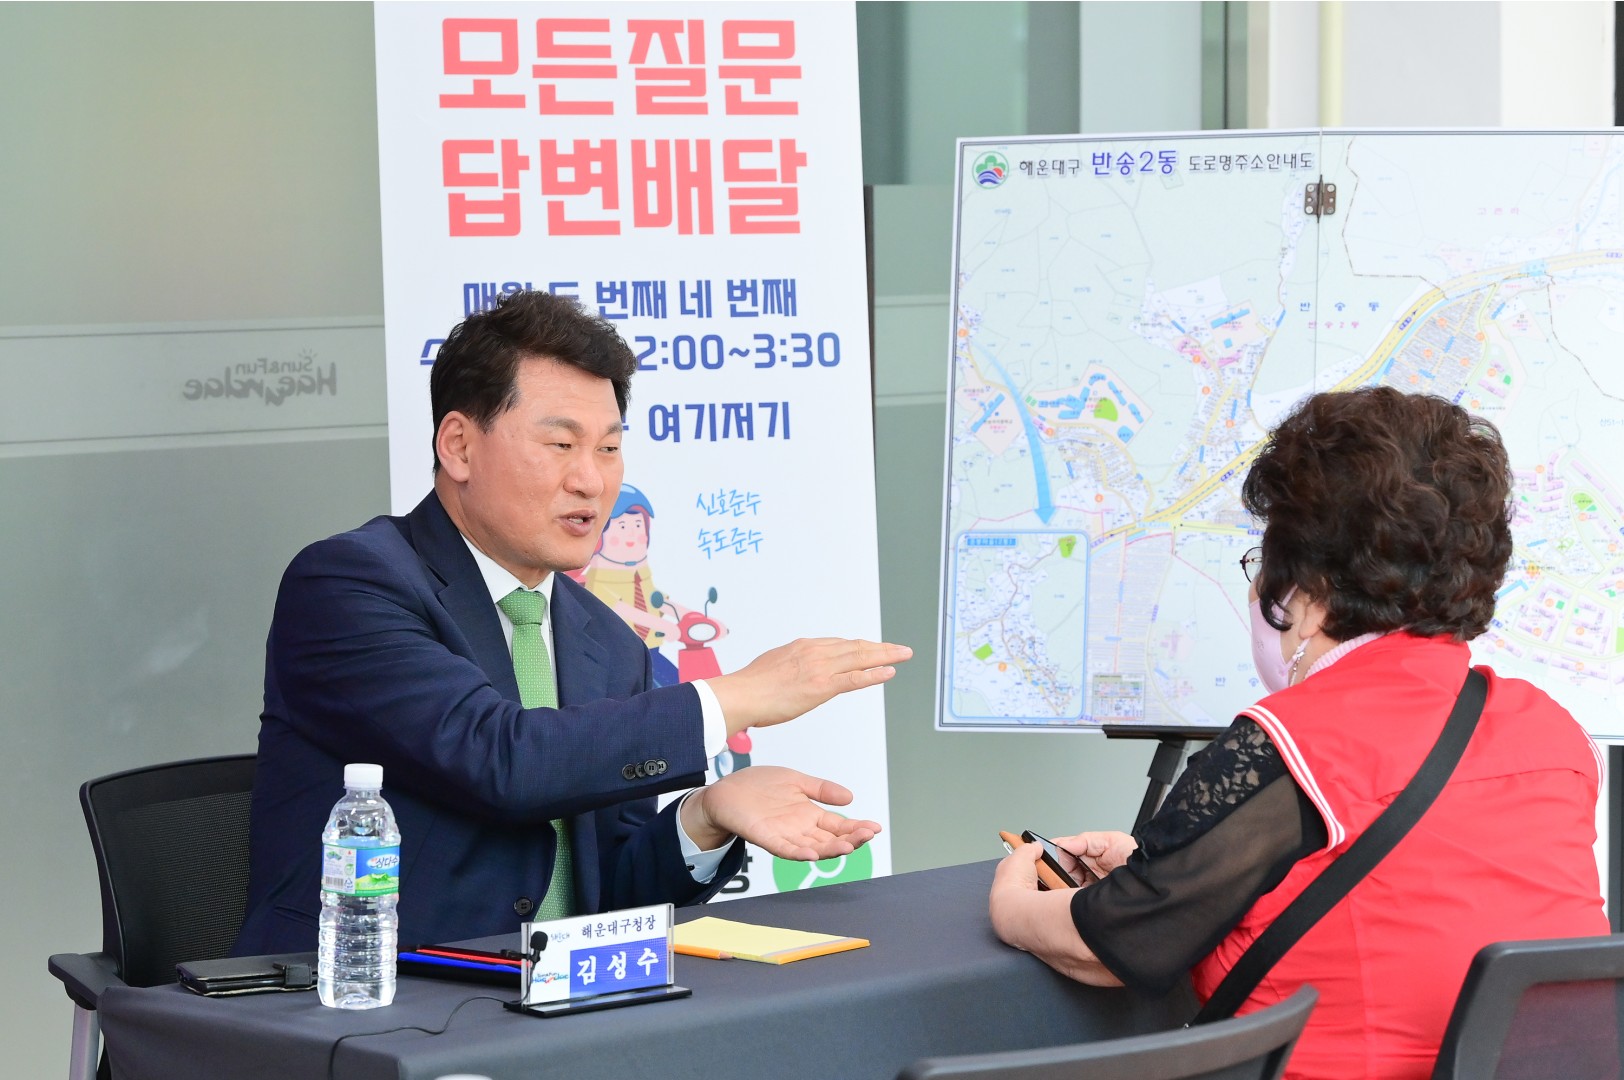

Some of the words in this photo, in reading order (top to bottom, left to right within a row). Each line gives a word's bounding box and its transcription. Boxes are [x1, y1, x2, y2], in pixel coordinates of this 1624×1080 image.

[1019, 158, 1081, 177] 해운대구
[1091, 149, 1177, 176] 반송2동
[1188, 152, 1314, 172] 도로명주소안내도
[596, 279, 667, 319] 번째
[679, 279, 712, 318] 네
[726, 278, 798, 318] 번째
[648, 401, 791, 443] 여기저기
[696, 488, 761, 517] 신호준수
[698, 527, 764, 560] 속도준수
[581, 915, 656, 940] 해운대구청장
